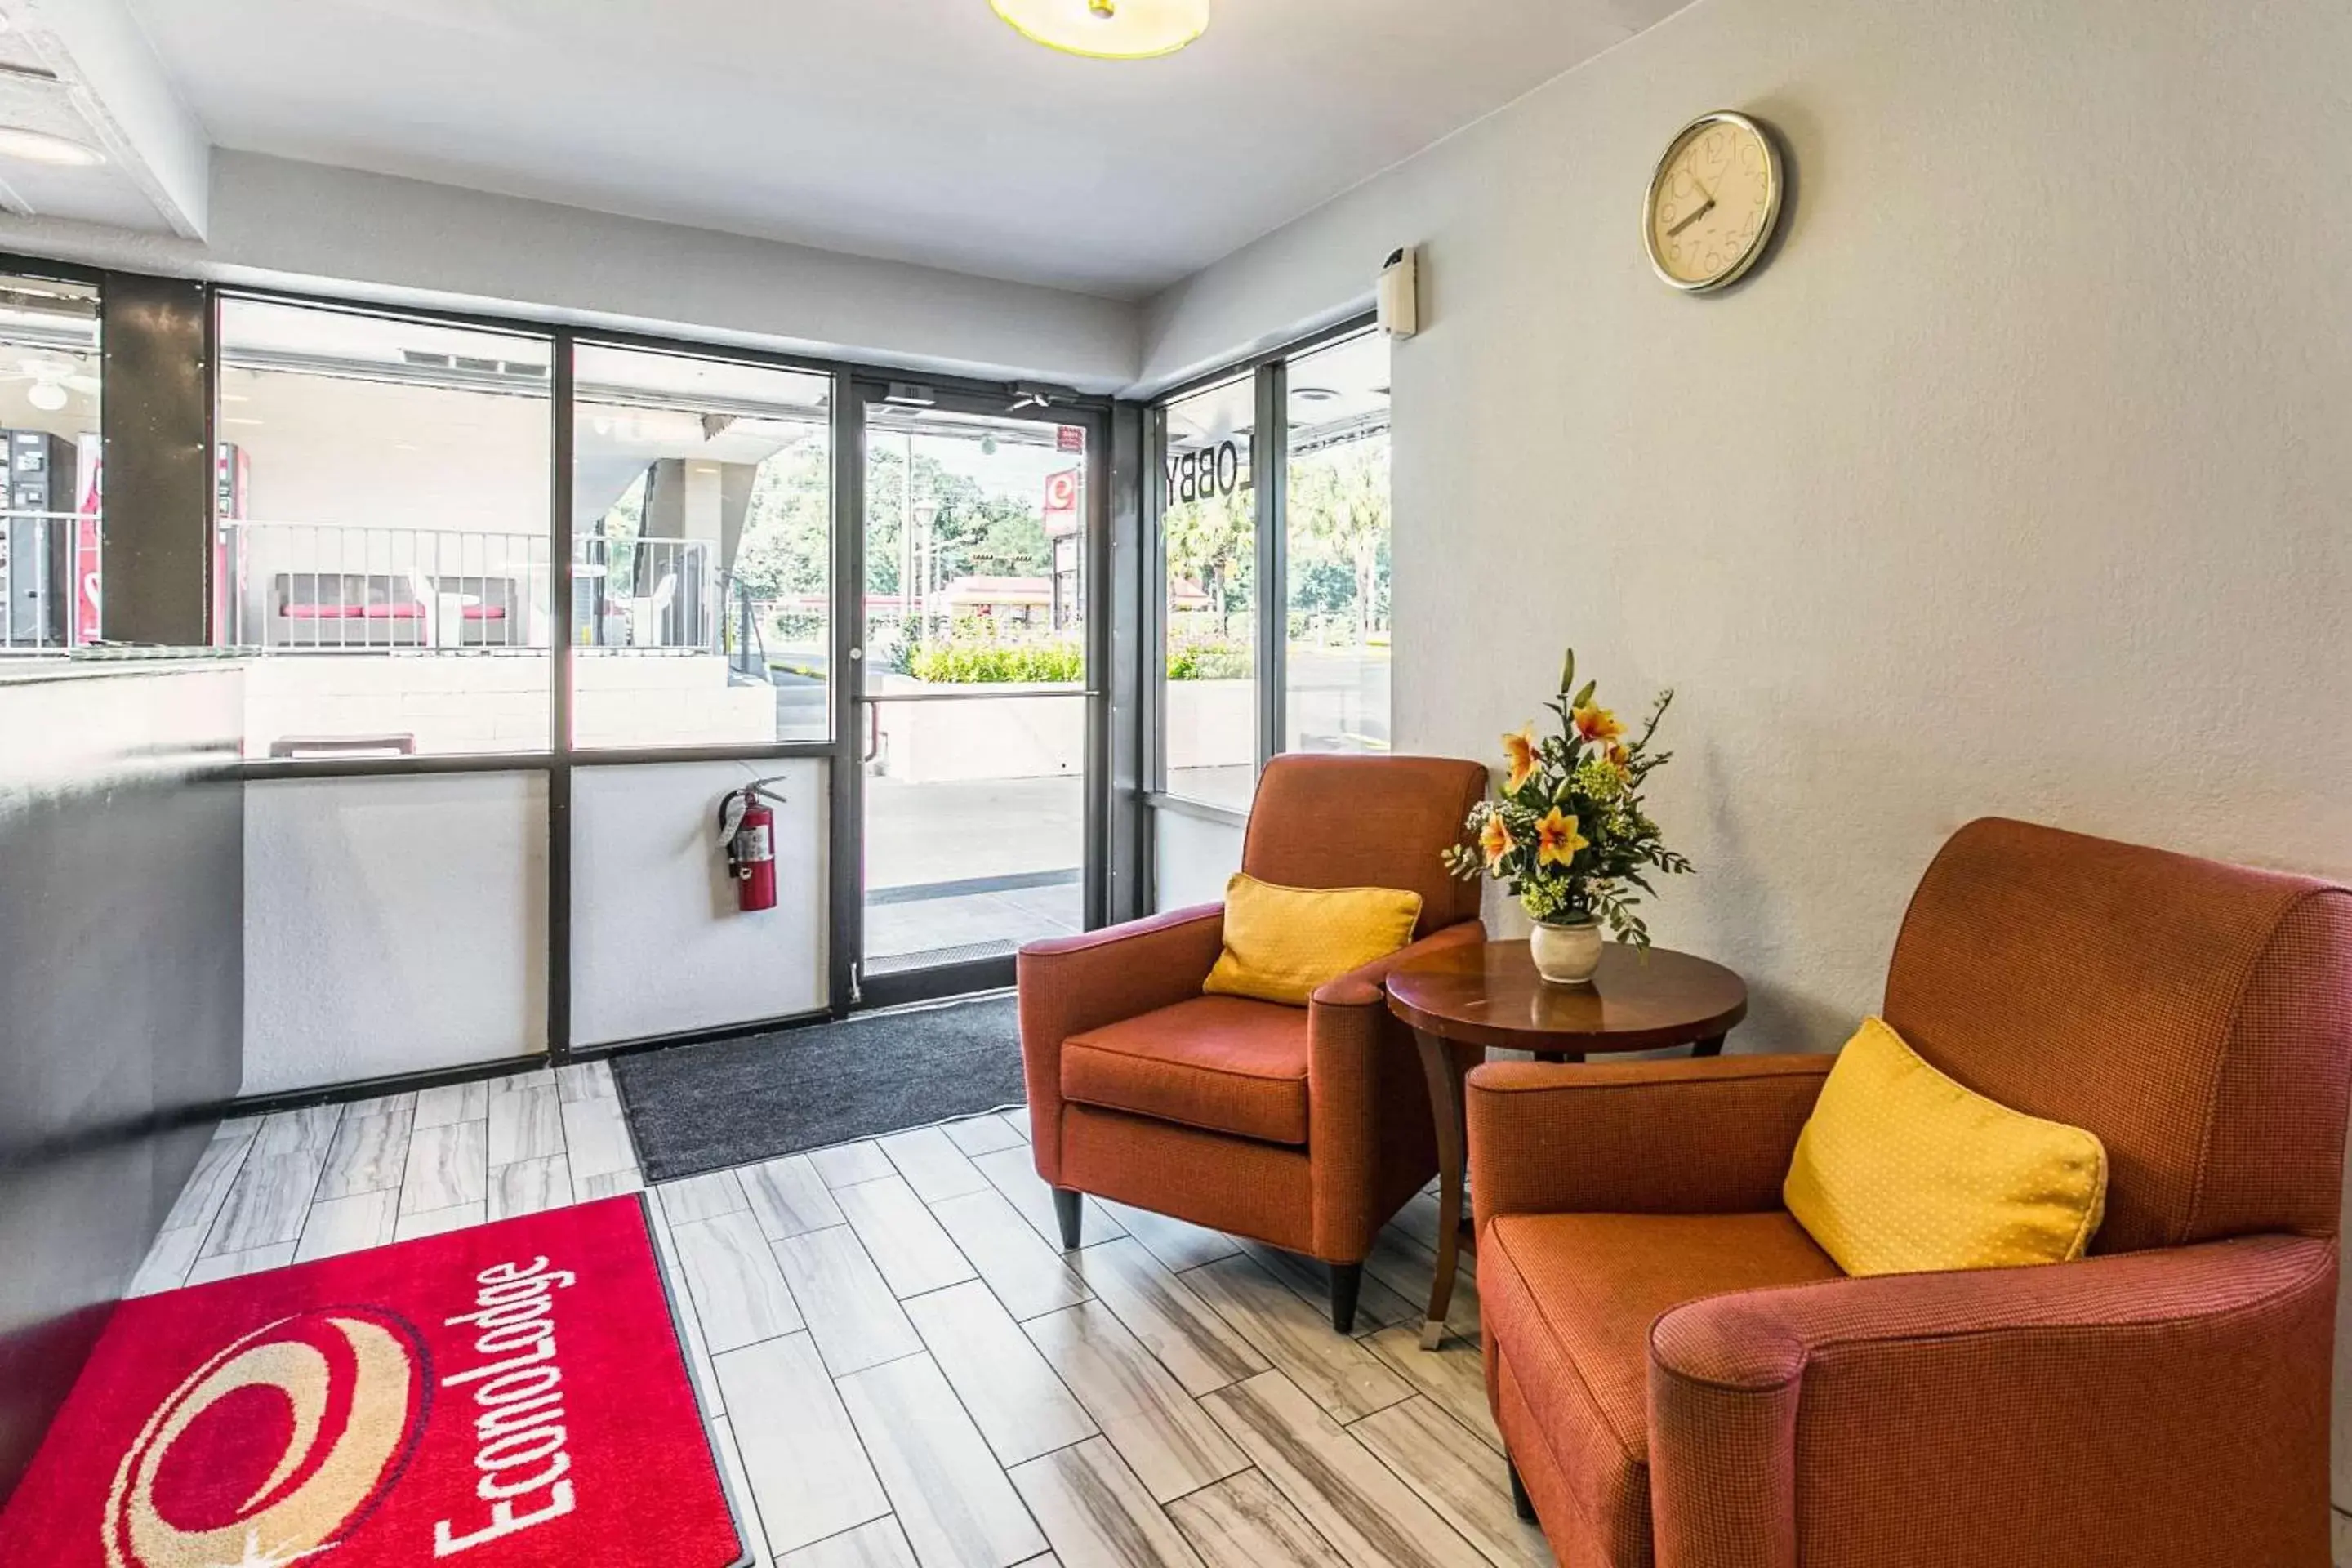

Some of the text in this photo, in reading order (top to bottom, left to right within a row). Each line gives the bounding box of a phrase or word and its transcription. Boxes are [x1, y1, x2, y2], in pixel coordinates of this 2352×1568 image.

[1705, 133, 1724, 164] 12
[1729, 132, 1737, 163] 1
[1741, 144, 1757, 176] 2
[1667, 170, 1693, 202] 10
[1740, 211, 1755, 237] 4
[1688, 240, 1701, 274] 7
